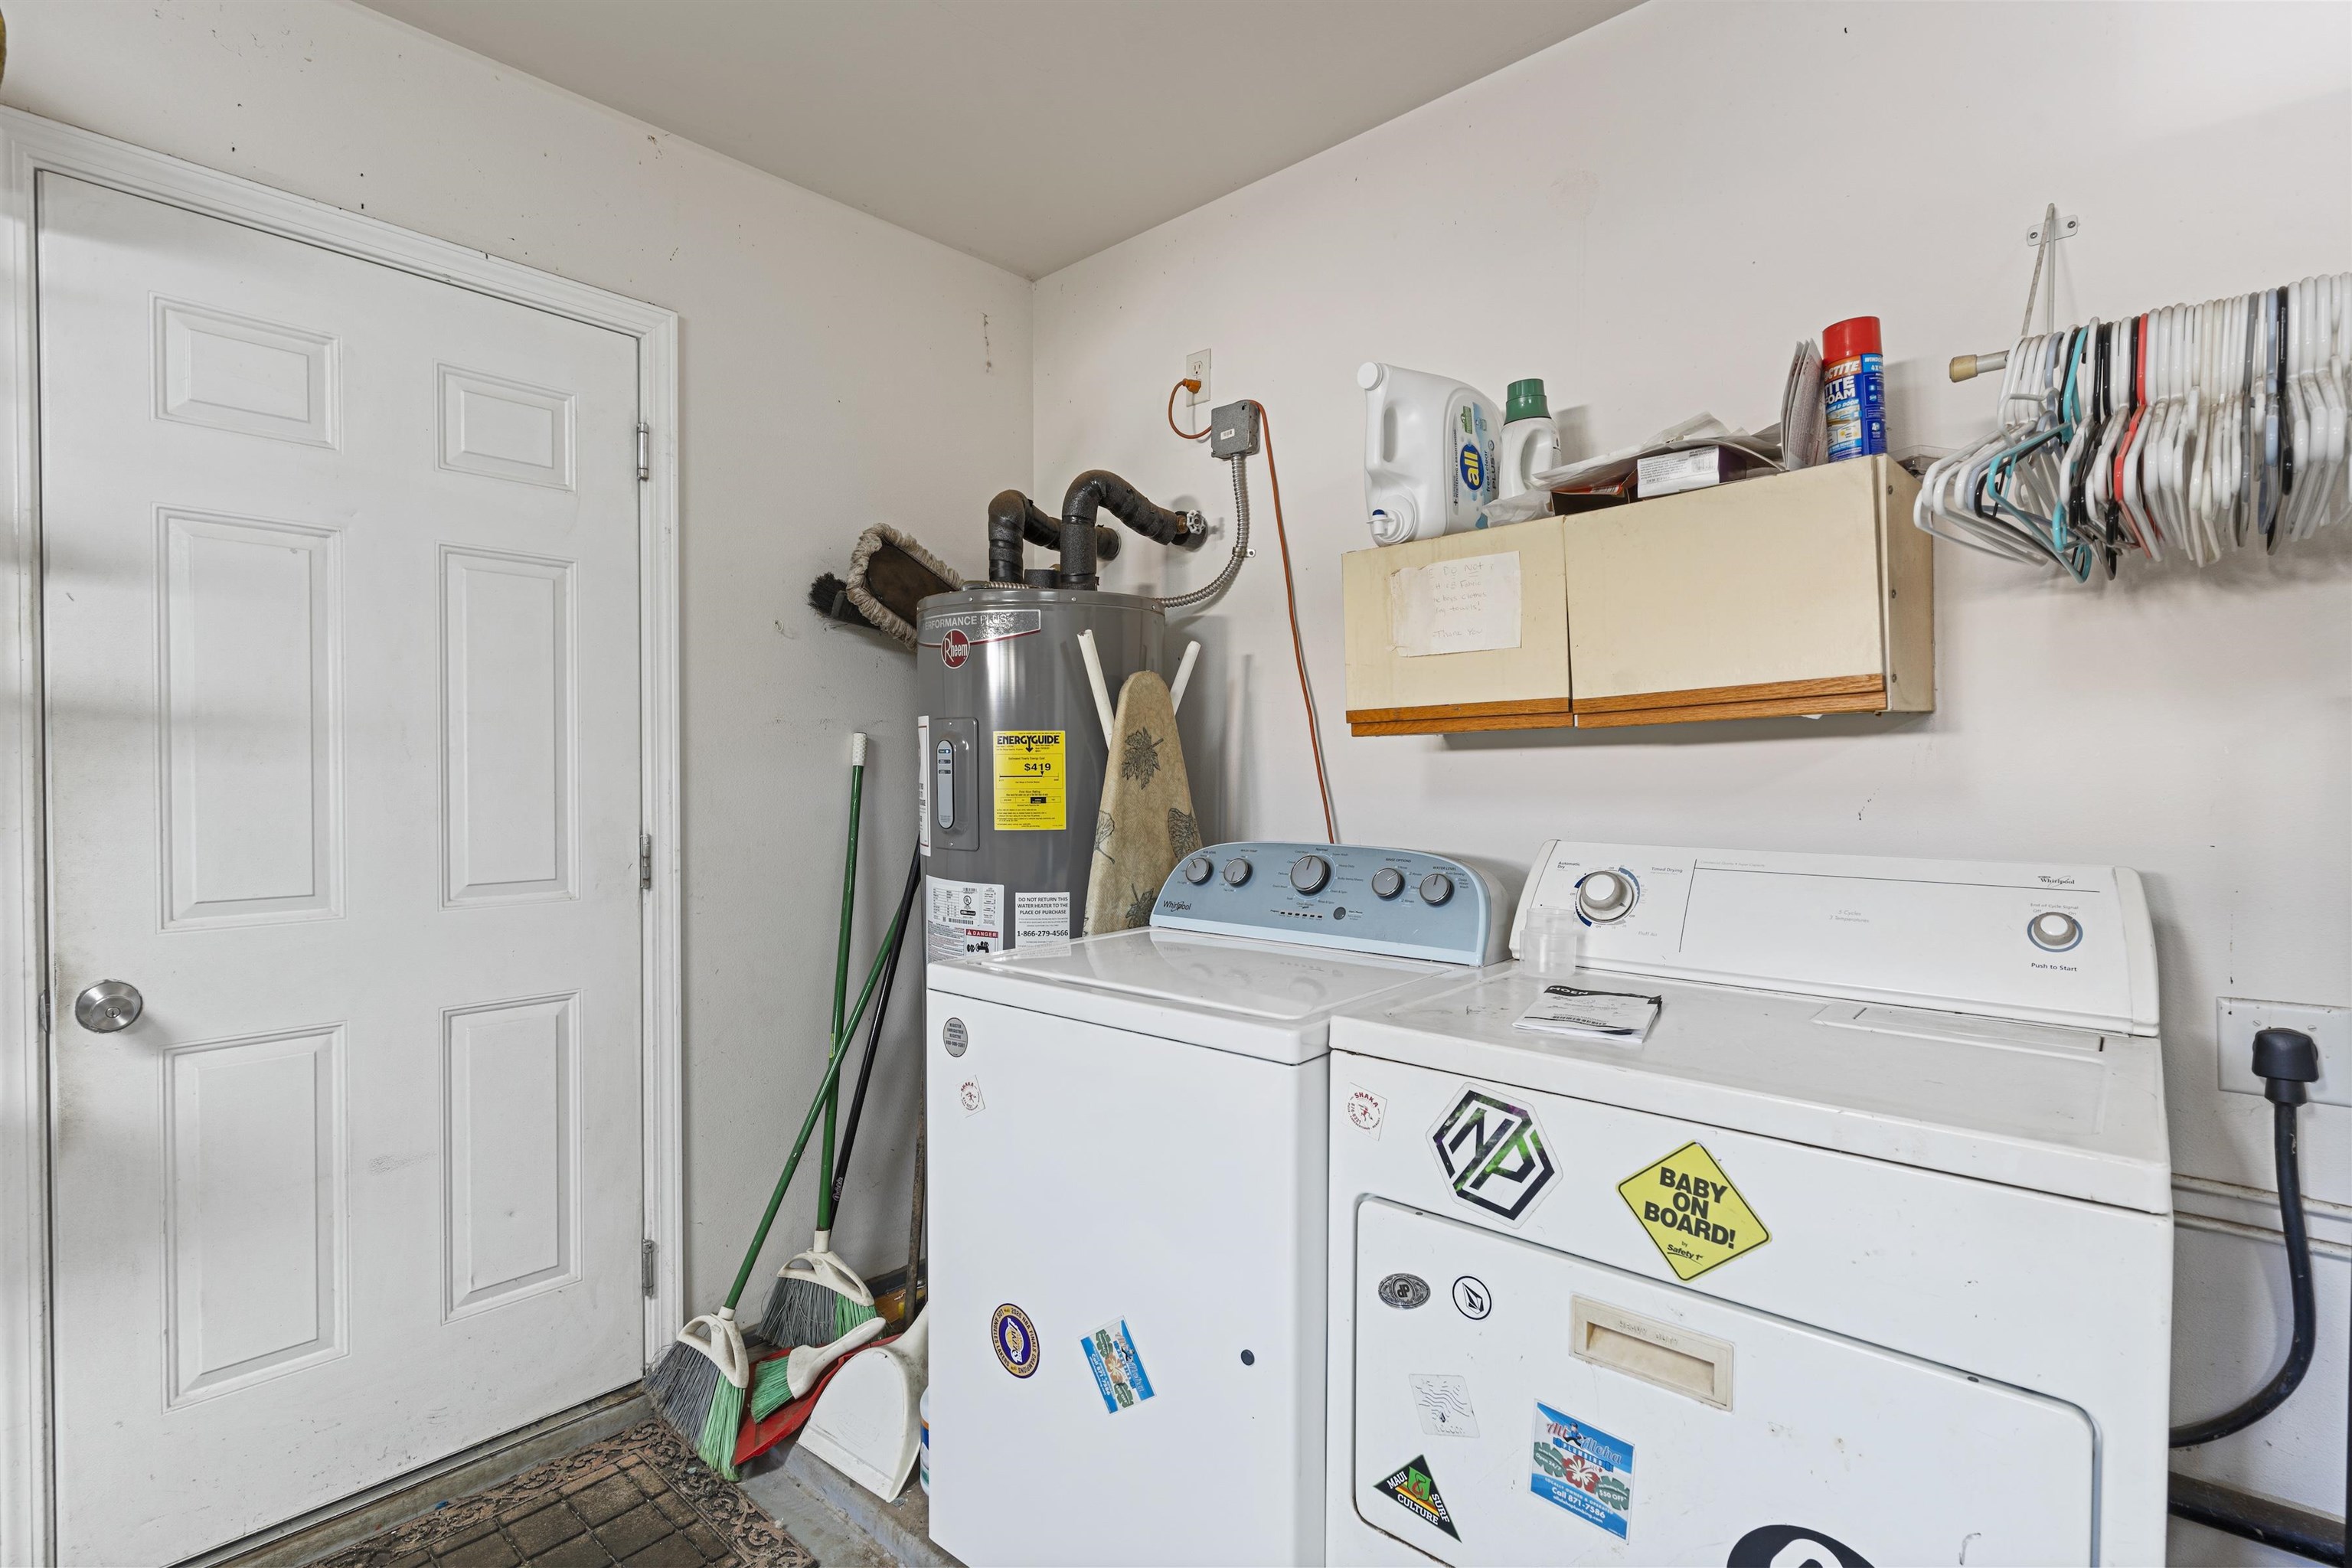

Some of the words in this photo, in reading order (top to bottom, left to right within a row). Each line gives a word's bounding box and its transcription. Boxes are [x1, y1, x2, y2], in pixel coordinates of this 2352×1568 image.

[1825, 360, 1860, 381] OCTITE
[1464, 451, 1480, 486] all
[980, 614, 1007, 624] PLUS
[945, 631, 968, 662] Rheem
[997, 735, 1060, 745] ENERGYGUIDE
[1024, 763, 1051, 772] $419
[1163, 900, 1191, 911] Whirlpool
[1354, 1093, 1378, 1107] SHAKA
[1660, 1167, 1728, 1204] BABY
[1673, 1192, 1709, 1220] ON
[1644, 1200, 1736, 1250] BOARD!
[1668, 1244, 1694, 1259] Safety
[1011, 1308, 1021, 1318] 2020
[1022, 1316, 1031, 1329] NBA
[996, 1345, 1009, 1367] LAKERS
[1018, 1354, 1037, 1374] CHAMPIONS
[1097, 1366, 1110, 1395] 871-7586
[1536, 1452, 1548, 1463] Open
[1549, 1461, 1561, 1470] 24/7
[1563, 1443, 1602, 1465] PLUMBING
[1581, 1437, 1622, 1464] Aloha
[1387, 1471, 1407, 1489] MAUI
[1545, 1478, 1563, 1489] LOCALLY
[1566, 1488, 1583, 1499] OWNED
[1589, 1500, 1613, 1514] OPERATED
[1552, 1487, 1566, 1498] Call
[1568, 1495, 1605, 1518] 871-7586
[1397, 1494, 1438, 1525] CULTURE
[1432, 1494, 1450, 1523] SURF
